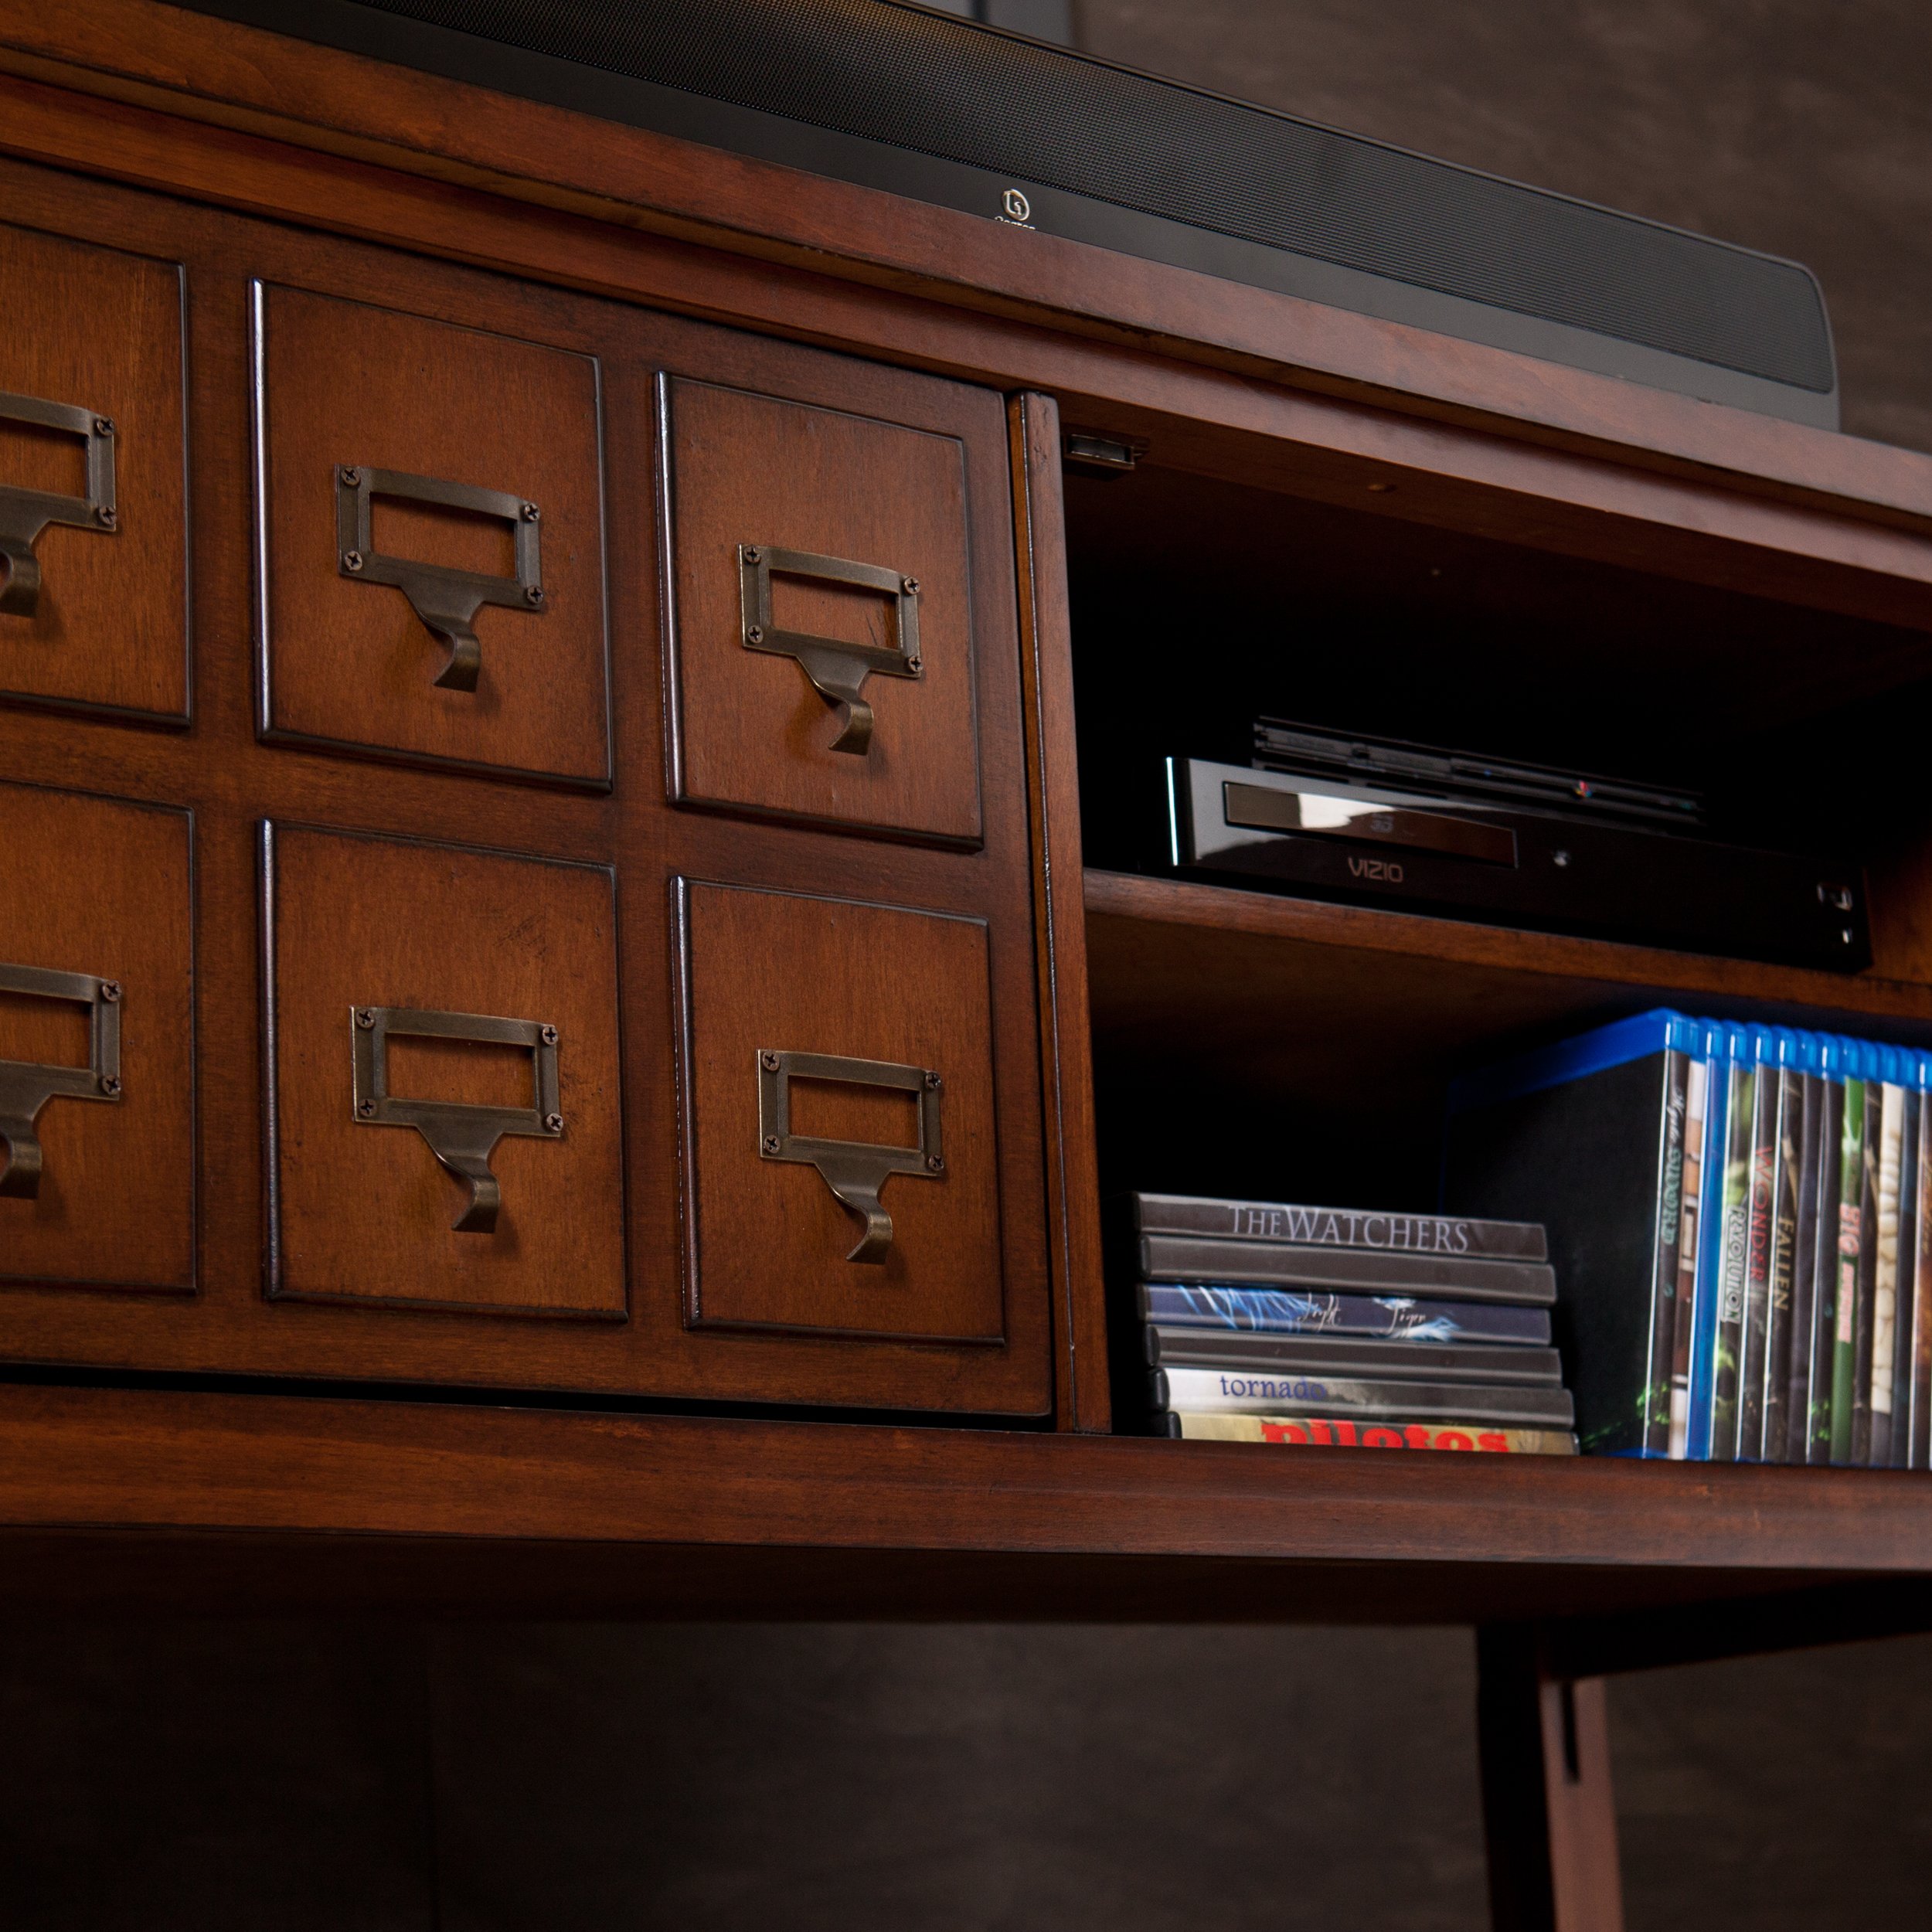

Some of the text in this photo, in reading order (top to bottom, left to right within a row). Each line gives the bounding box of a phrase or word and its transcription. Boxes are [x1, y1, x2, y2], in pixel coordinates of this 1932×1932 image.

[1349, 857, 1403, 883] VIZIO
[1750, 1145, 1774, 1283] WONDER
[1772, 1216, 1796, 1311] FALLEN
[1219, 1374, 1328, 1401] tornado
